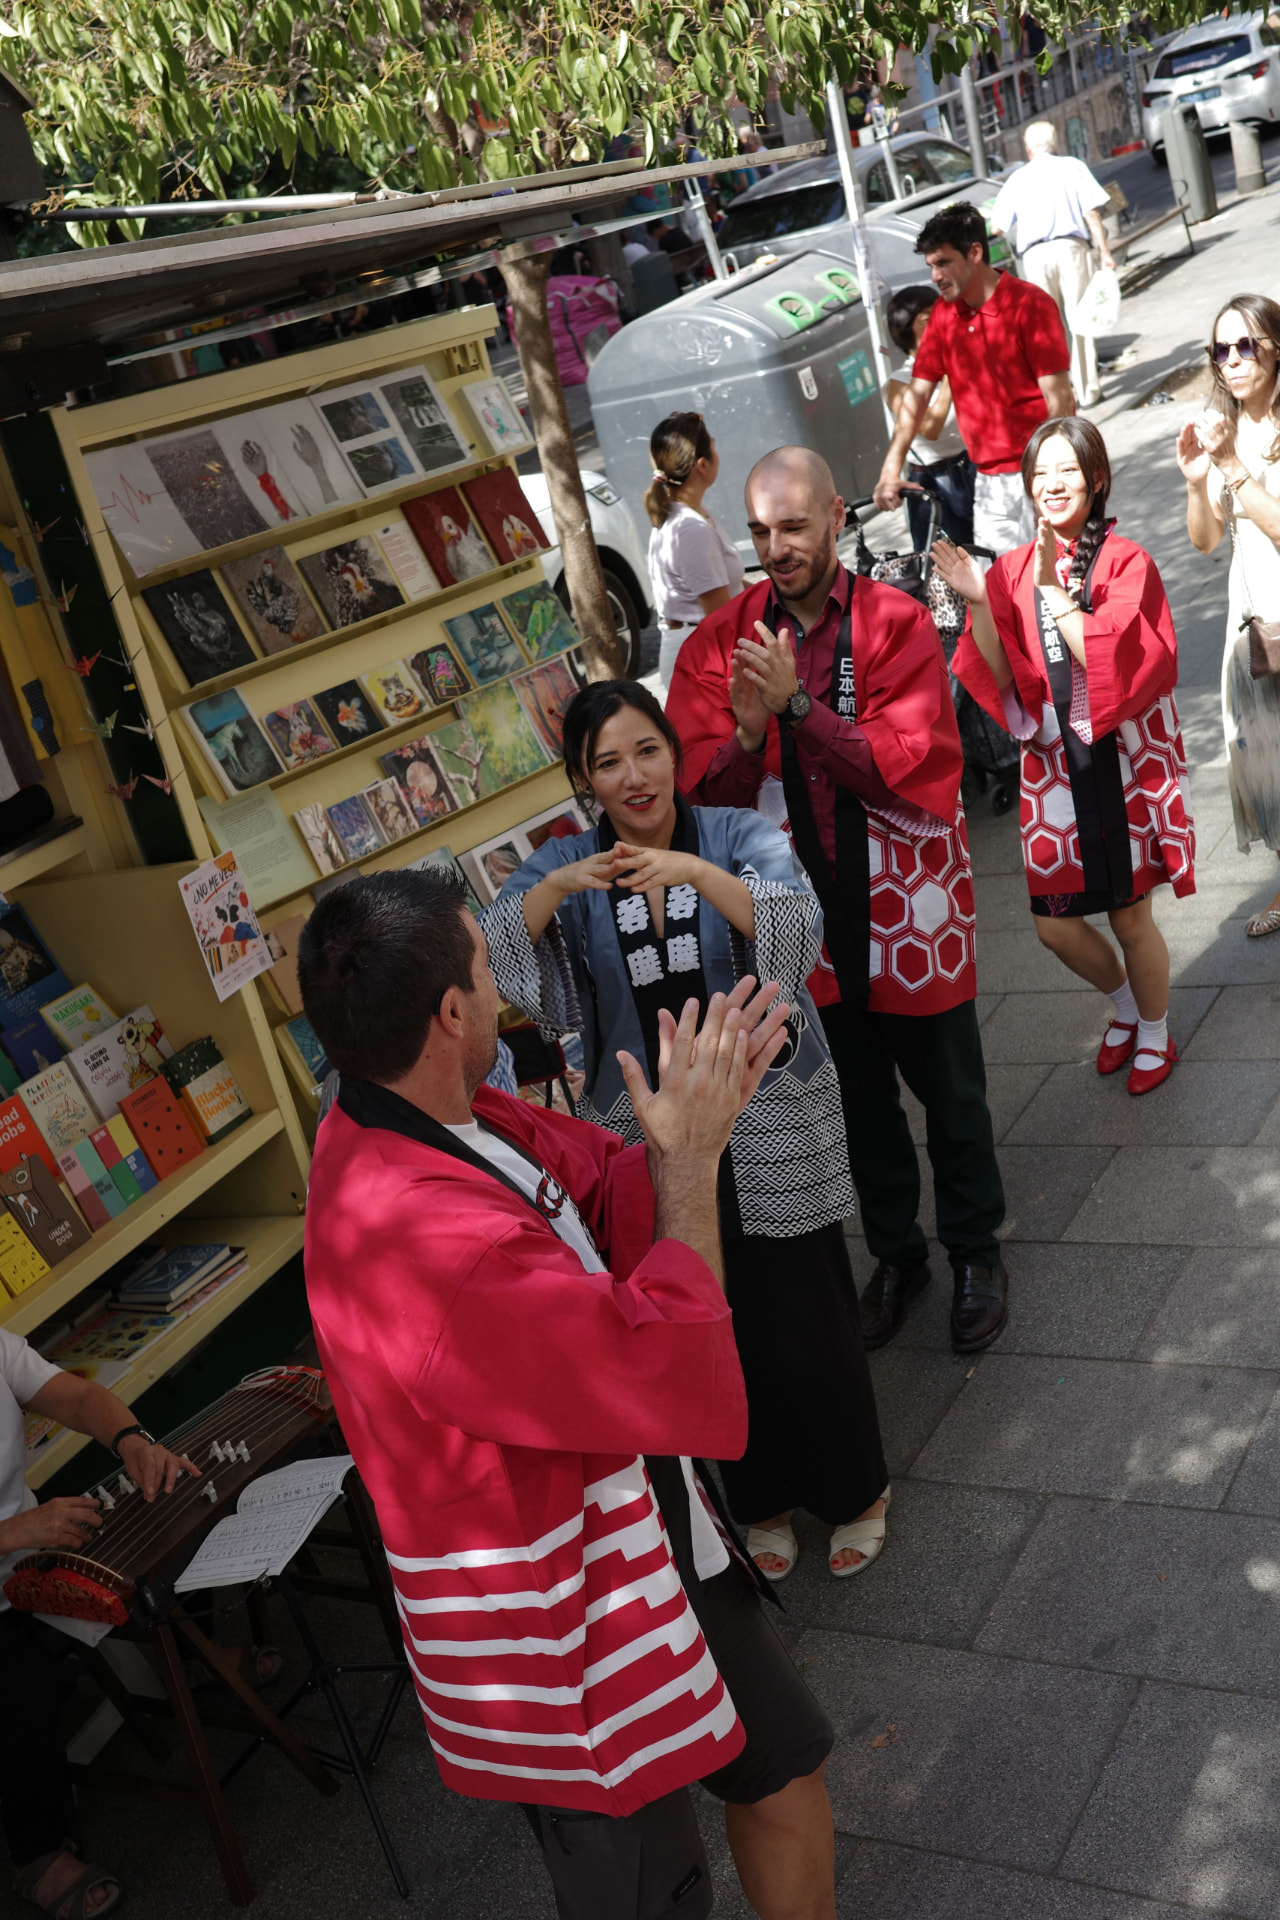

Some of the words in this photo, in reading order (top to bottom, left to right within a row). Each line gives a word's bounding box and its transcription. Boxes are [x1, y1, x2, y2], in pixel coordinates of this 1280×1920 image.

[193, 883, 208, 905] ¿NO
[209, 874, 220, 893] ME
[218, 861, 237, 882] VES?
[52, 993, 95, 1023] RAKUGAKI
[89, 1059, 103, 1072] LIBRO
[194, 1076, 235, 1109] Blackie
[201, 1093, 237, 1121] Books
[48, 1220, 71, 1241] UNDER
[55, 1231, 73, 1246] DOGS
